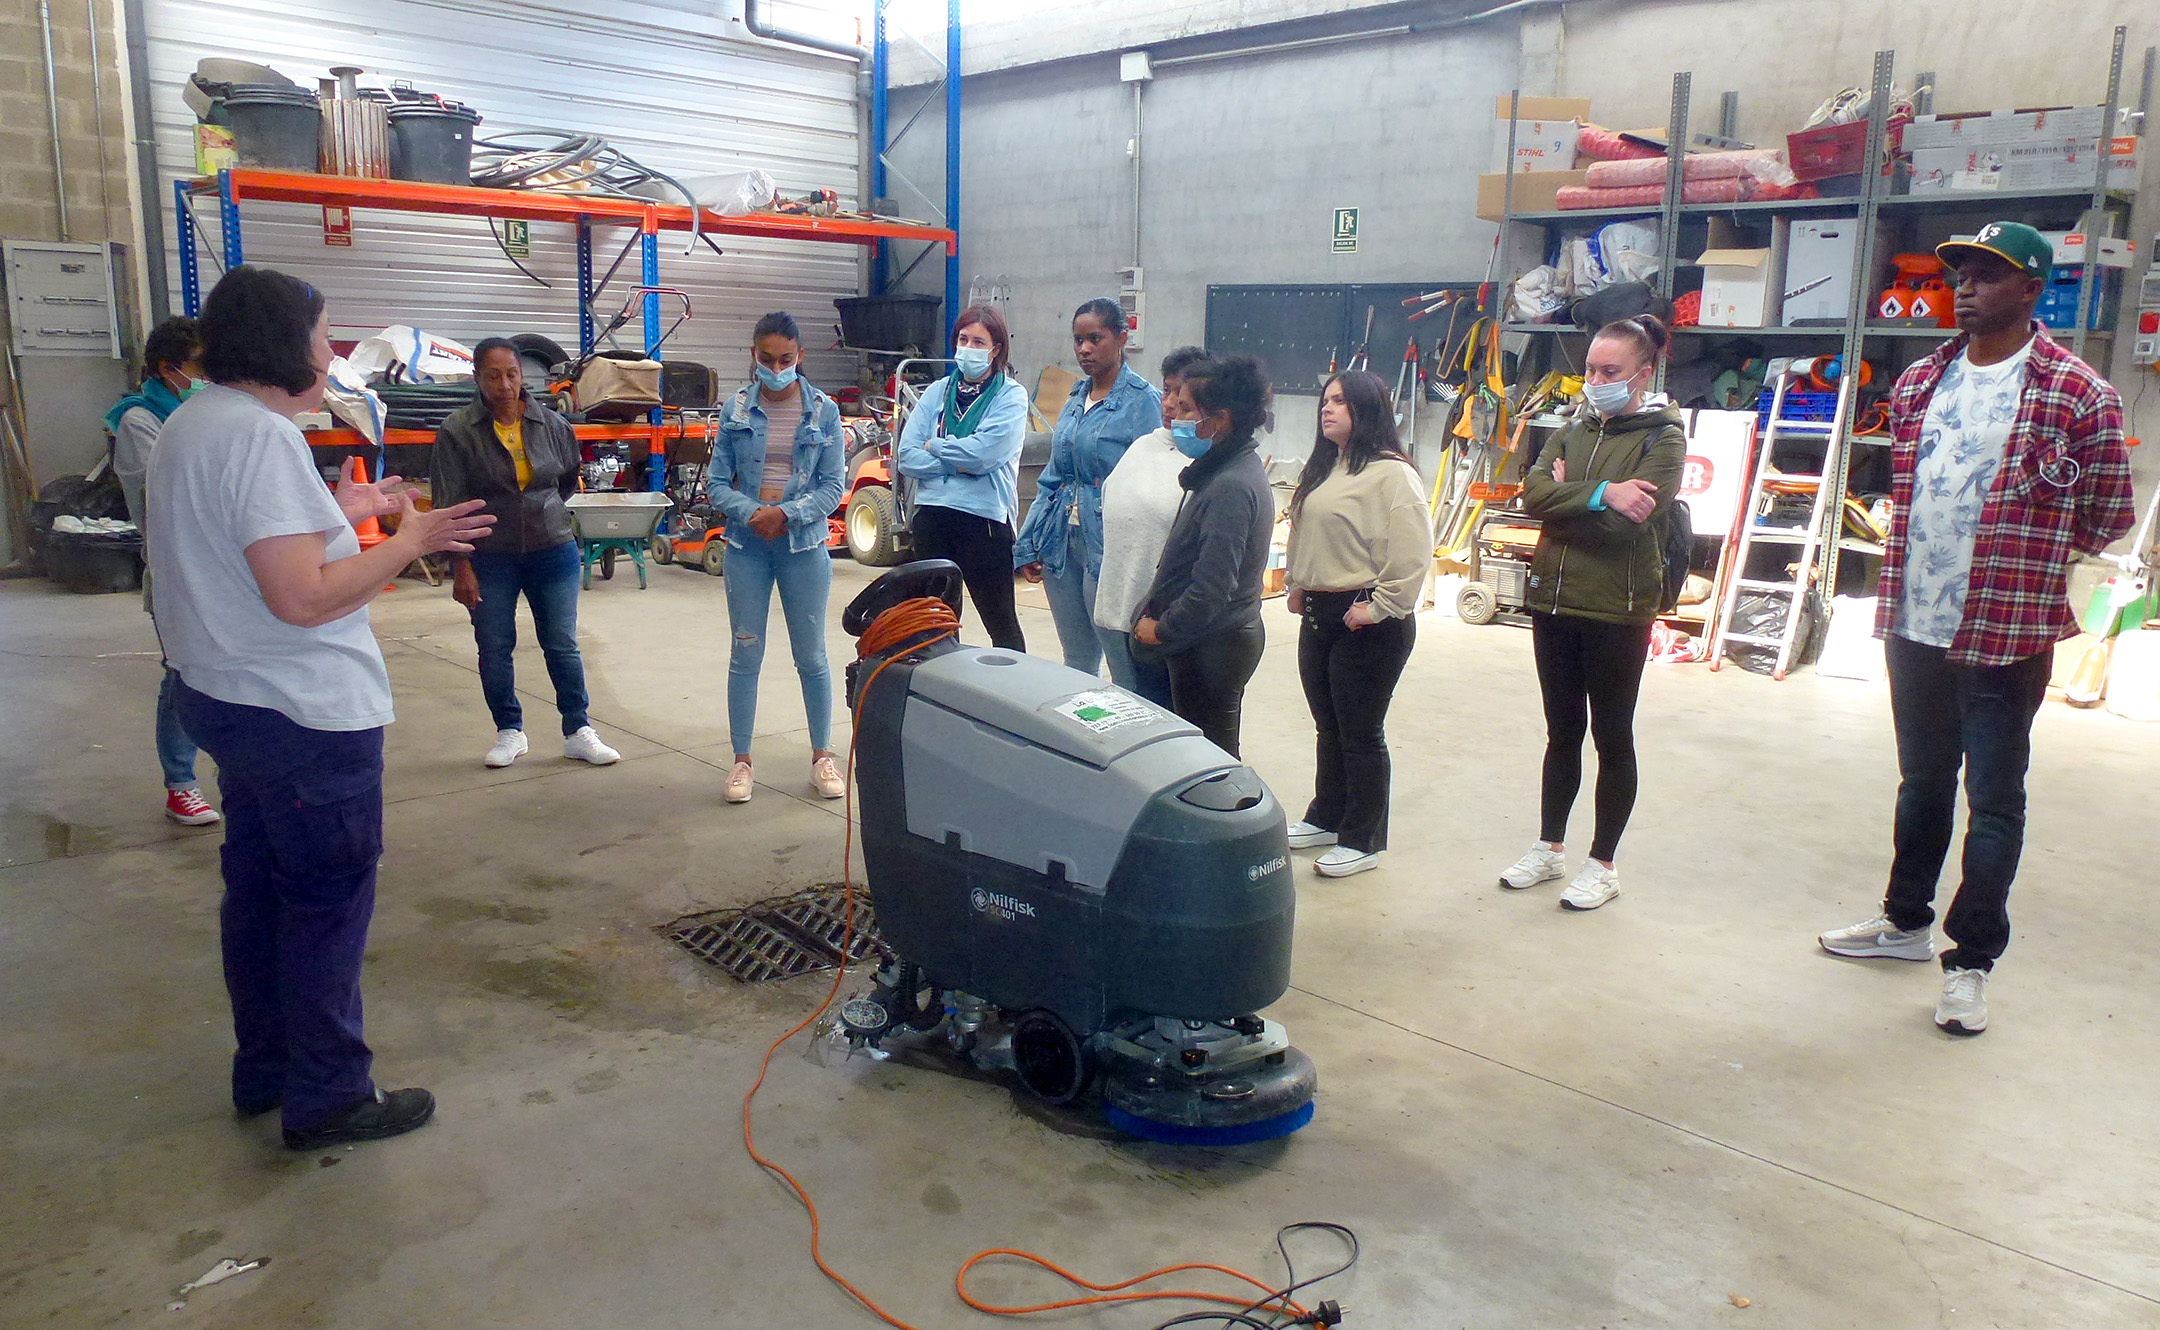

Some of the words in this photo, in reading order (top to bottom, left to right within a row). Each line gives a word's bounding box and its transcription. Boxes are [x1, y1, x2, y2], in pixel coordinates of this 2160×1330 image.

[1516, 148, 1545, 157] STIHL
[1553, 140, 1562, 153] 9
[1258, 855, 1287, 877] Nilfisk
[989, 892, 1036, 918] Nilfisk
